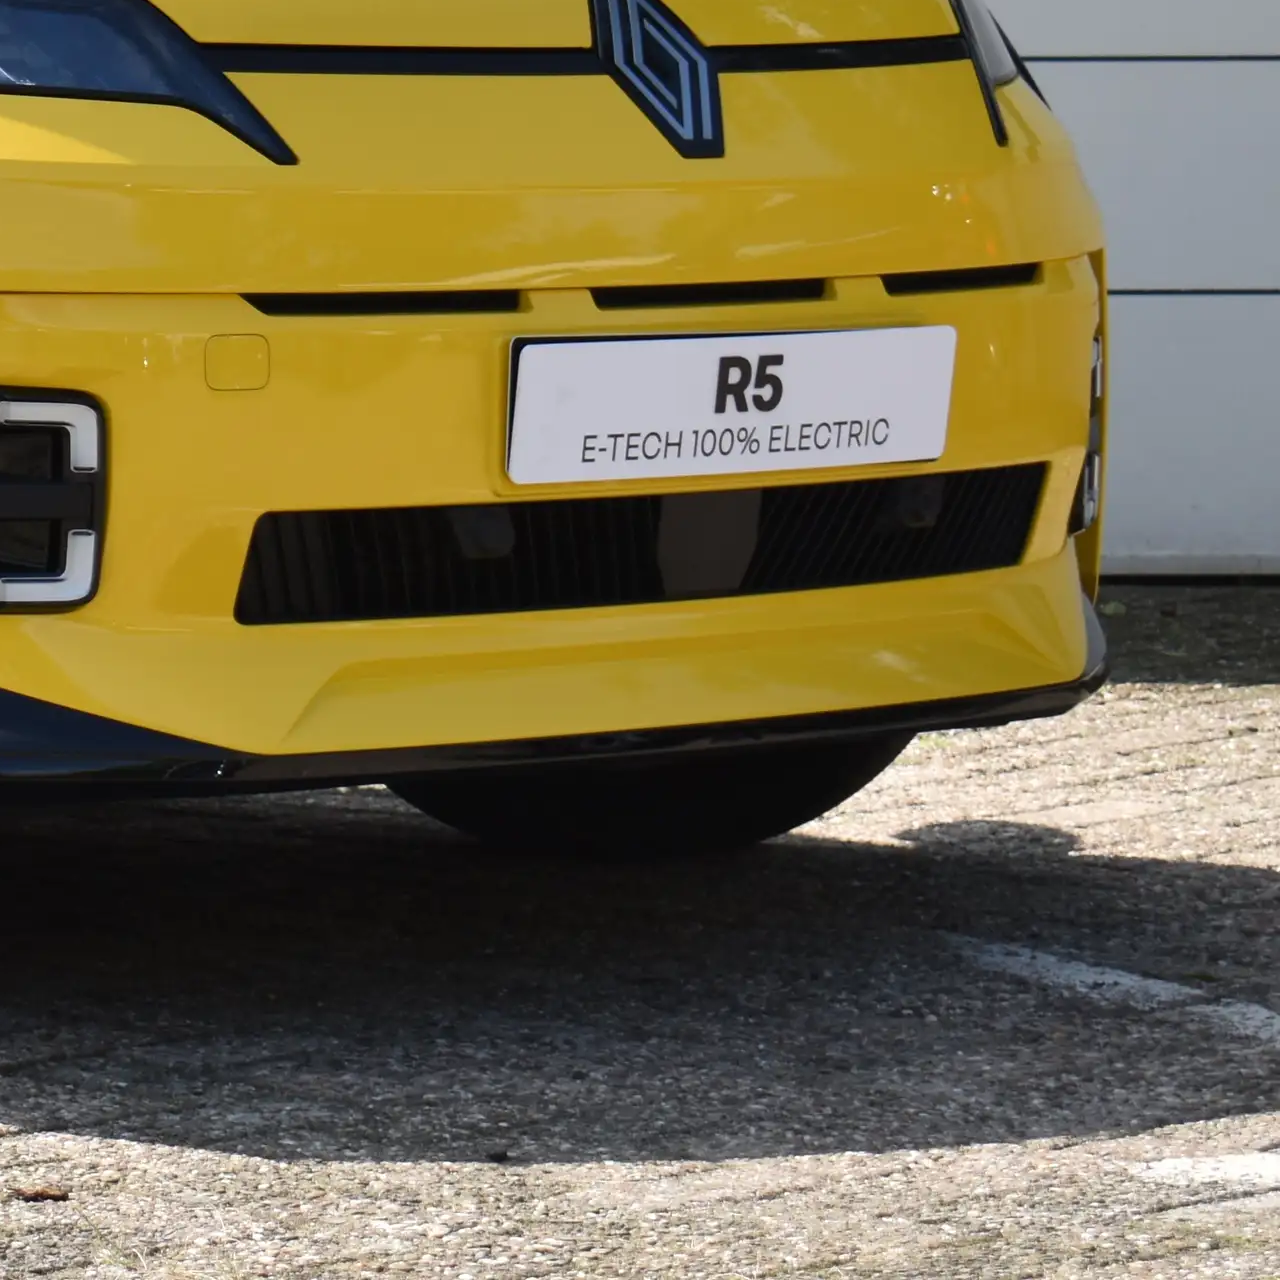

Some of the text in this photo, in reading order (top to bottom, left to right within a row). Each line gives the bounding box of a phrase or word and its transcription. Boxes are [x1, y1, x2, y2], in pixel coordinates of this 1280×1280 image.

[714, 353, 785, 414] R5
[580, 417, 891, 463] E-TECH 100% ELECTRIC
